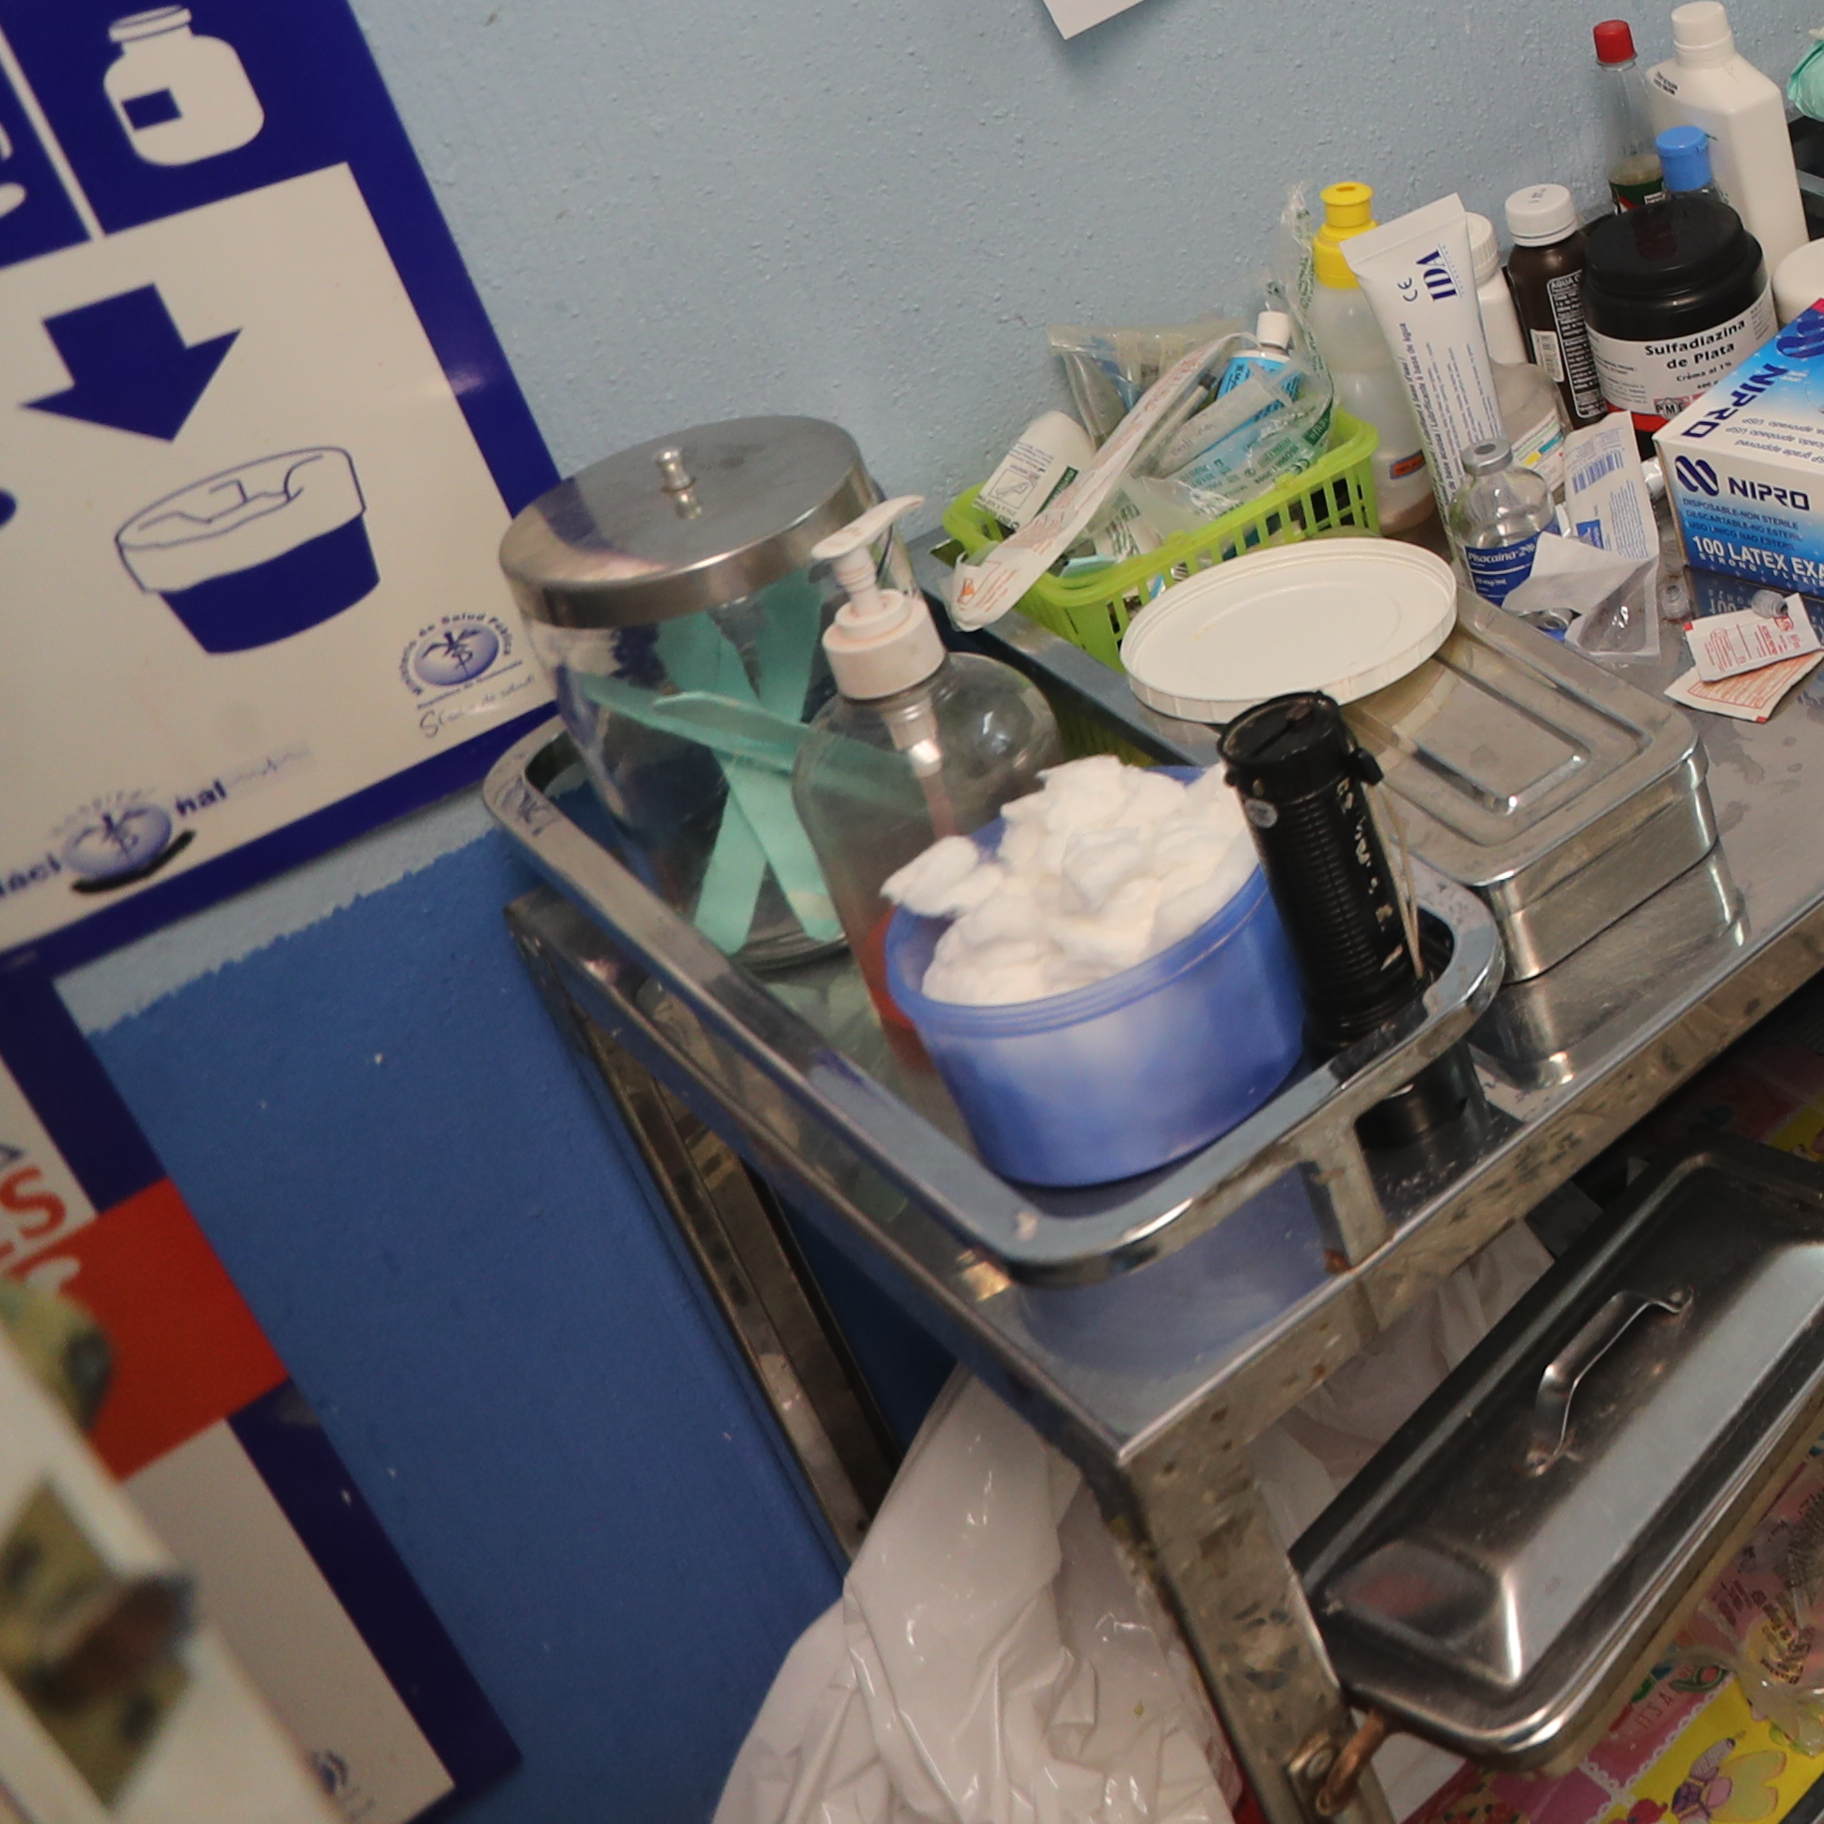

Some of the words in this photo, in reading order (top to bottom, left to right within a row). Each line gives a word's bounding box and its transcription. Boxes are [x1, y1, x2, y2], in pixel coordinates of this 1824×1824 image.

[1416, 247, 1458, 302] IDA
[1644, 318, 1746, 357] Sulfadiazina
[1666, 358, 1689, 370] de
[1694, 341, 1736, 364] Plata
[1680, 363, 1790, 439] NIPRO
[1726, 427, 1749, 436] USP
[1735, 438, 1782, 456] approved
[1782, 447, 1814, 463] grade
[1728, 476, 1811, 512] NIPRO
[1682, 497, 1761, 522] DISPOSABLE-NON
[1761, 514, 1799, 530] STERILE
[1693, 534, 1725, 558] 100
[1727, 541, 1790, 573] LATEX
